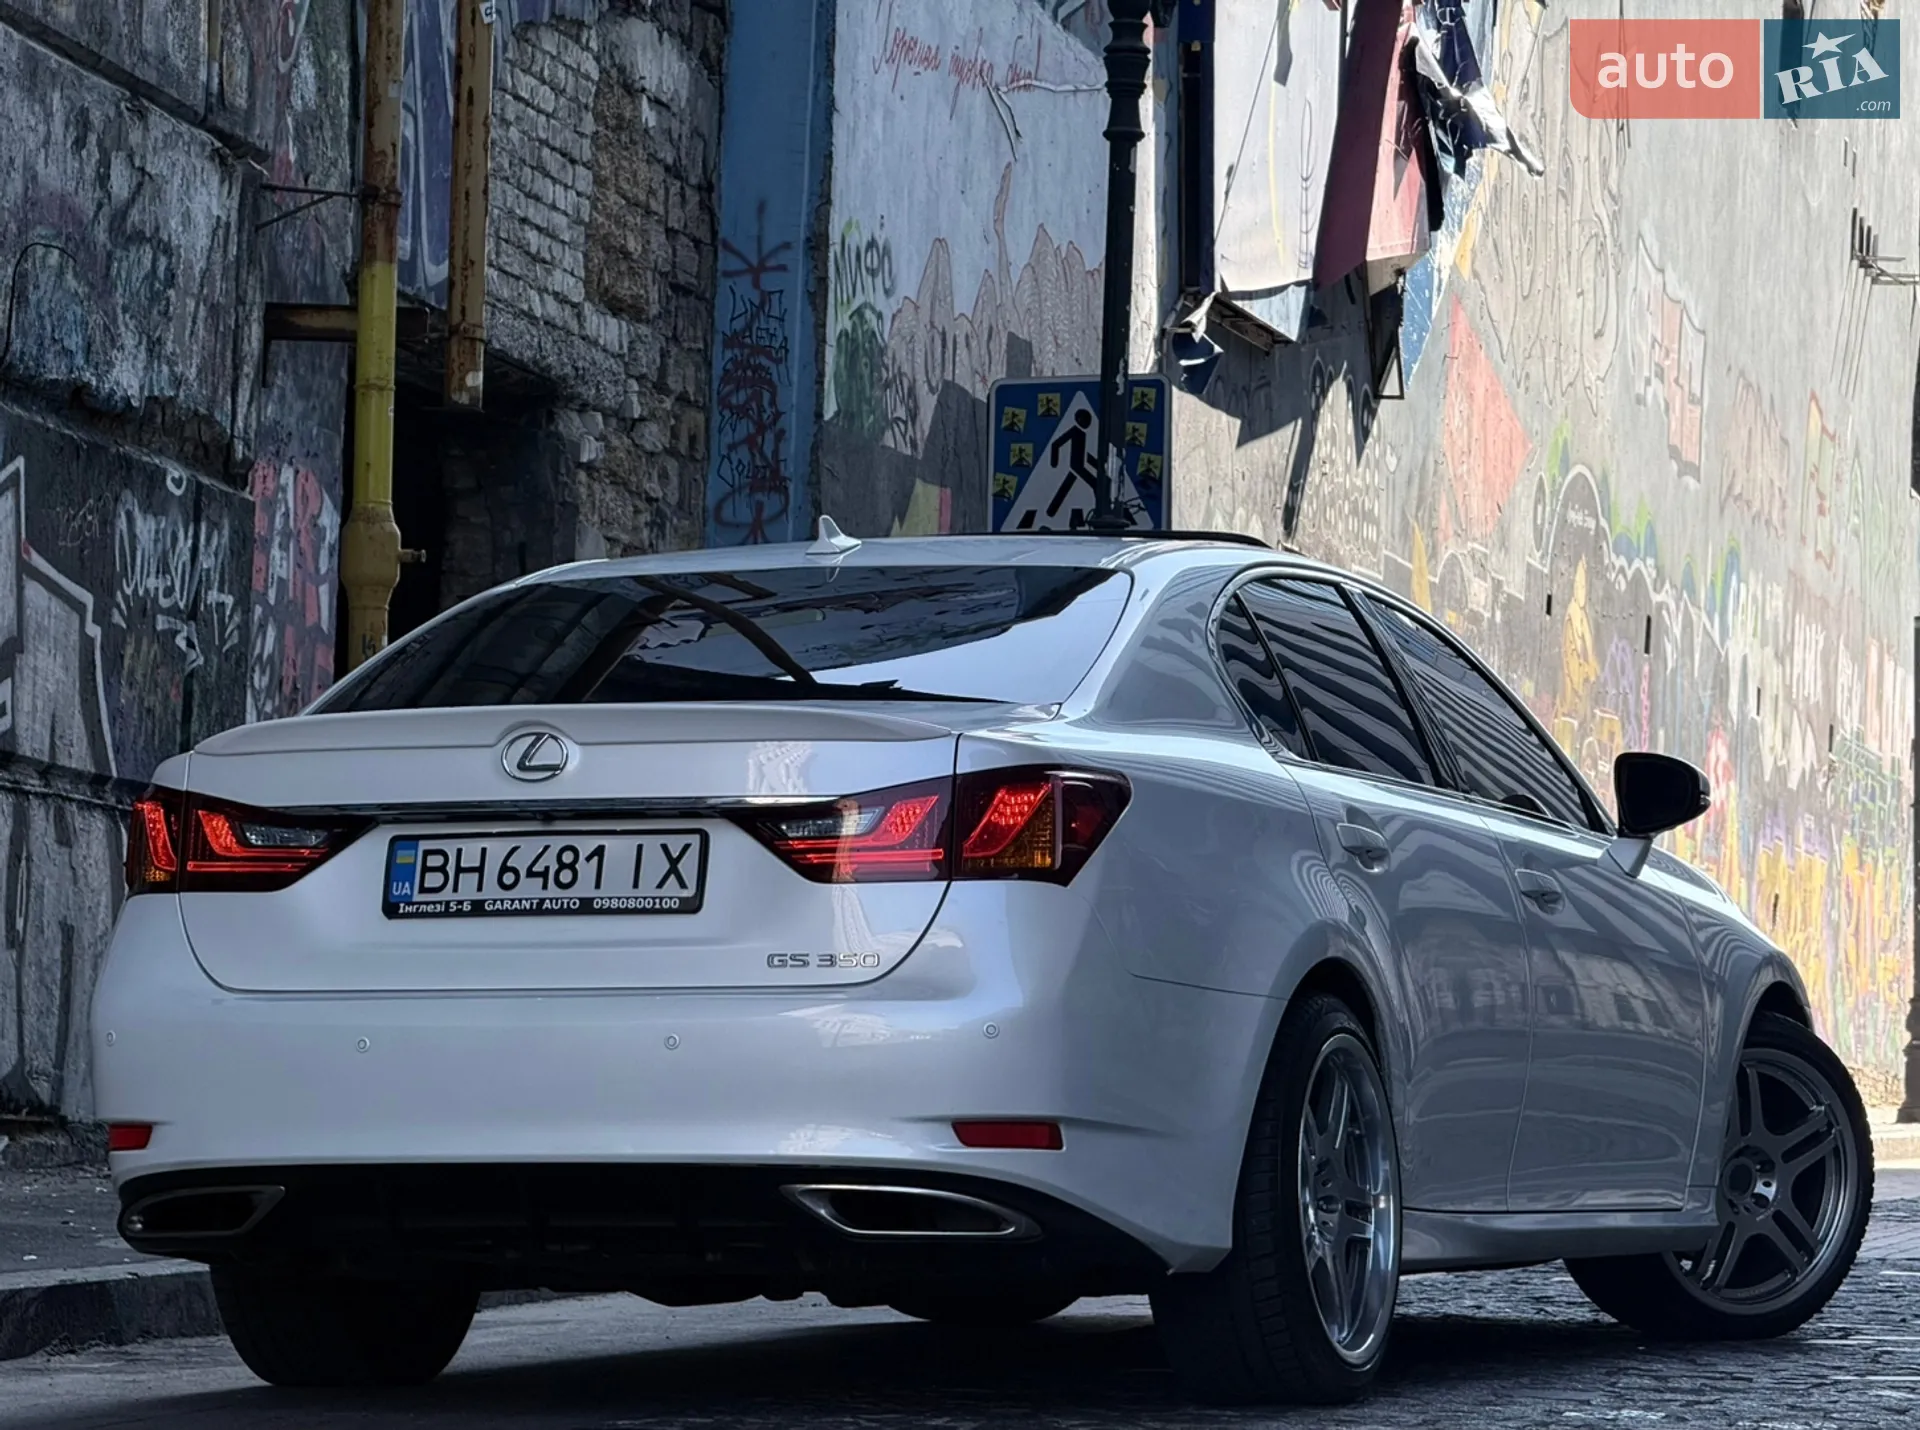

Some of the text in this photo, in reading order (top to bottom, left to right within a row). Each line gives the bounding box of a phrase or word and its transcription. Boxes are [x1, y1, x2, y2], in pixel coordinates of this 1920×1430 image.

[417, 846, 488, 895] BH
[496, 843, 607, 892] 6481
[392, 881, 412, 897] UA
[398, 902, 445, 914] Інглезі
[483, 898, 540, 911] GARANT
[542, 897, 580, 910] AUTO
[593, 897, 680, 909] 0980800100
[766, 951, 881, 969] GS 350
